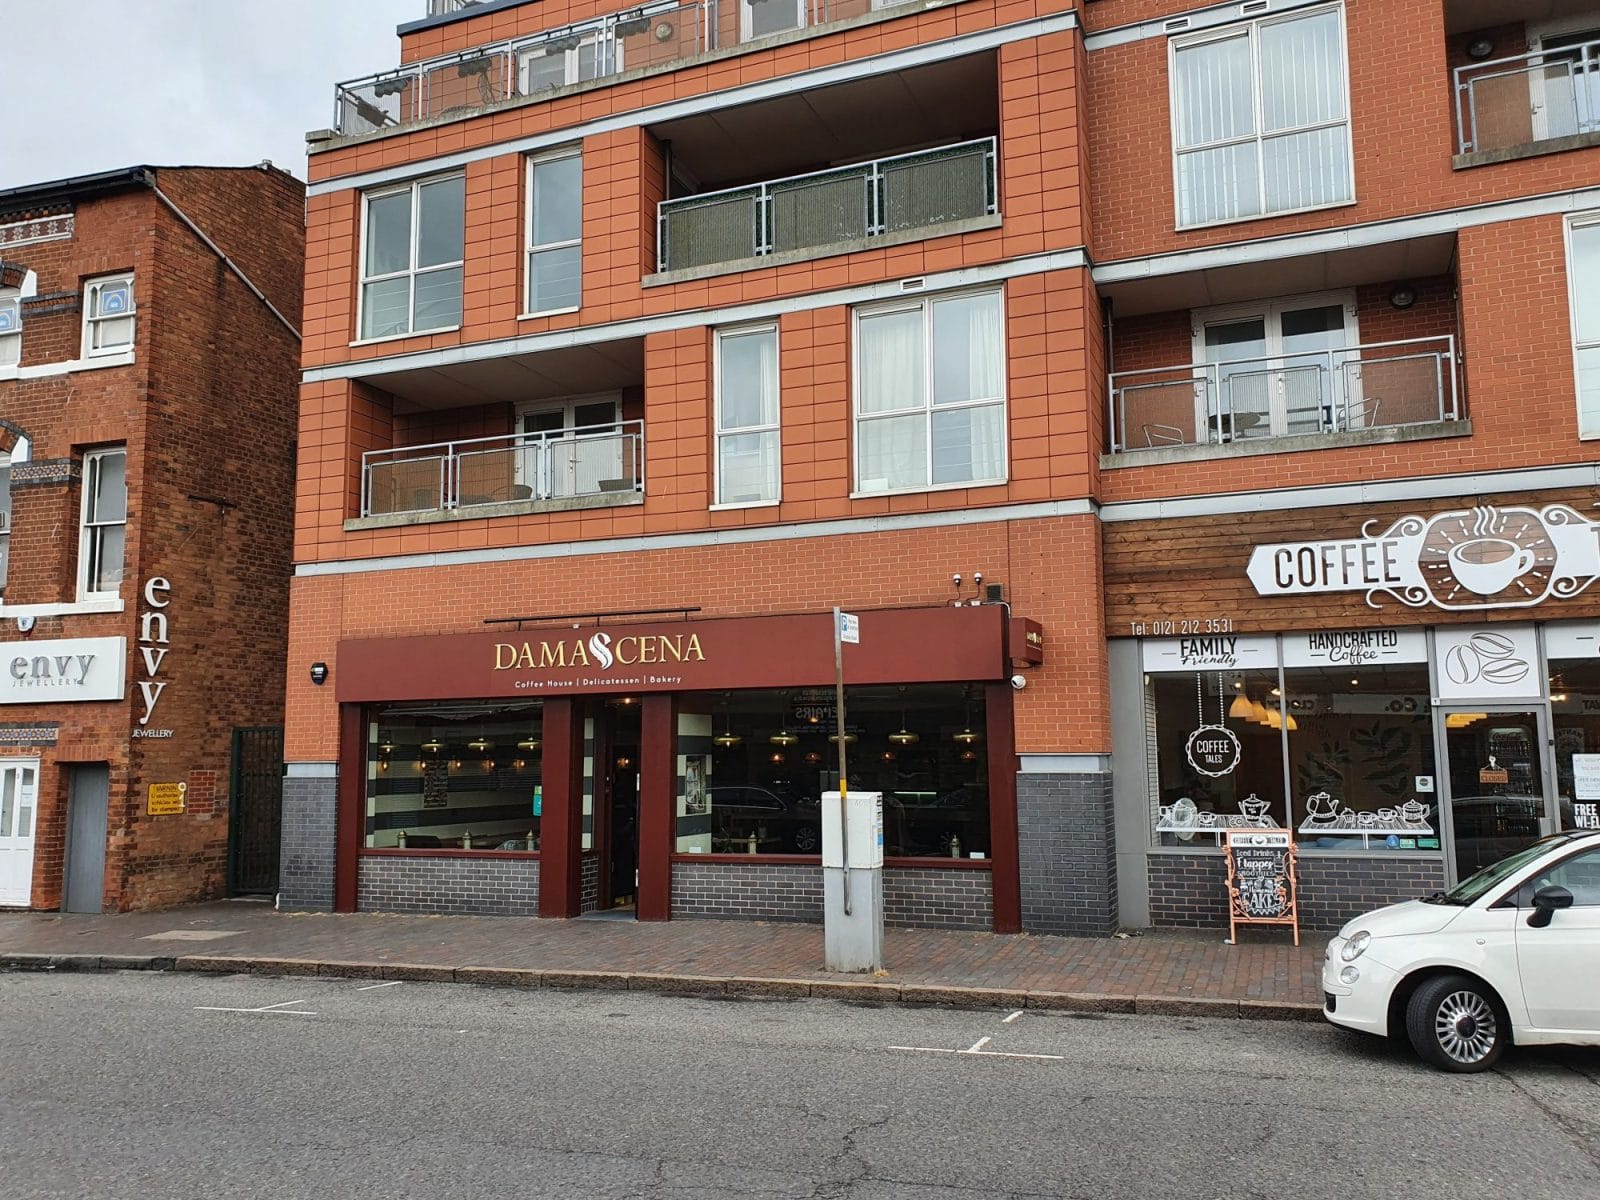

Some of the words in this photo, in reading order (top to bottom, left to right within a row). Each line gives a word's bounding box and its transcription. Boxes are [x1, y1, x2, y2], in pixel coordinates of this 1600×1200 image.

[1274, 541, 1400, 588] COFFEE
[1130, 622, 1149, 635] Tel:
[1153, 621, 1175, 635] 0121
[1181, 620, 1200, 634] 212
[1205, 618, 1233, 633] 3531
[1180, 637, 1238, 656] FAMILY
[1309, 630, 1398, 650] HANDCRAFTED
[138, 577, 171, 725] envy
[494, 632, 706, 671] DAMASCENA
[1329, 645, 1379, 665] Coffee
[1181, 654, 1240, 667] Friendly
[10, 655, 96, 685] envy
[12, 678, 78, 688] JEWELLERY
[515, 680, 544, 689] Coffee
[547, 679, 573, 687] House
[583, 676, 640, 686] Delicatessen
[650, 675, 682, 685] Bakery
[132, 730, 173, 738] JEWELLERY
[1196, 740, 1230, 753] COFFEE
[1205, 754, 1223, 764] TALES
[1574, 804, 1597, 815] FREE
[1574, 815, 1599, 829] WI-FI
[1236, 849, 1251, 857] Iced
[1253, 849, 1275, 857] Drinks
